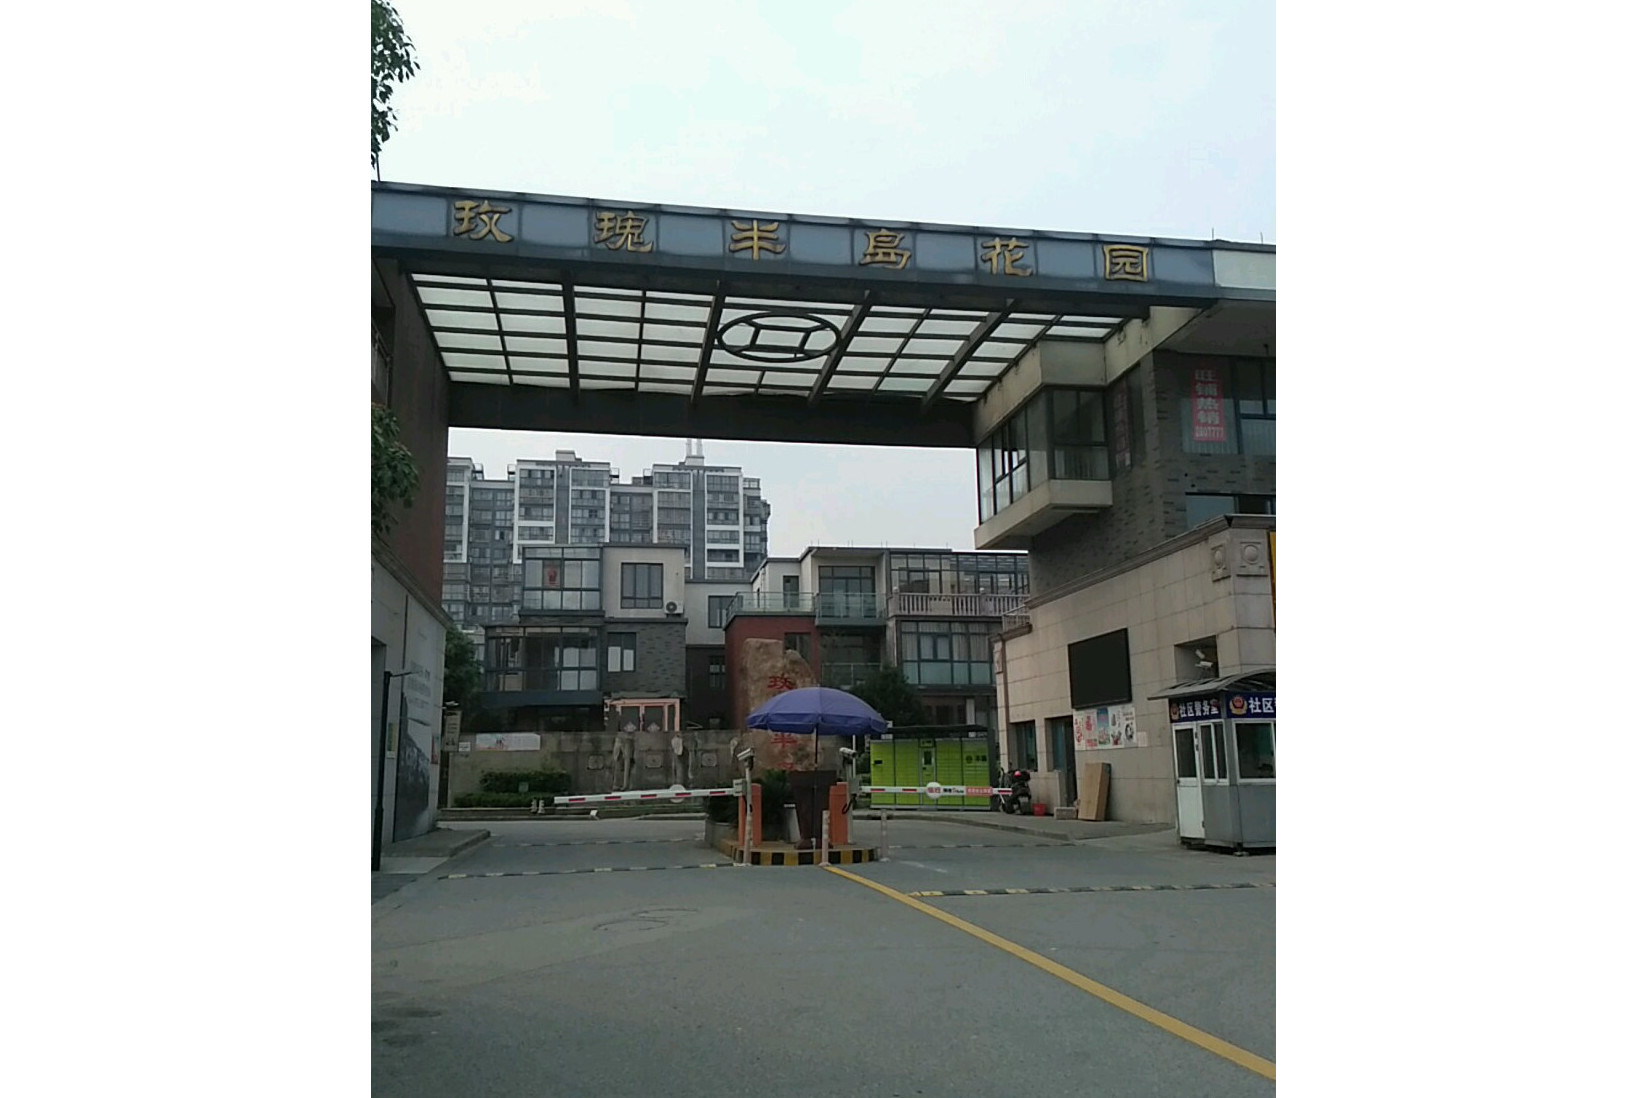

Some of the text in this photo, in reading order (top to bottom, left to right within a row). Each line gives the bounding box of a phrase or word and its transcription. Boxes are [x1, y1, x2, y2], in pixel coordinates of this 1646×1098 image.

[452, 199, 1151, 284] 玫瑰半岛花园
[1248, 696, 1276, 714] 社区
